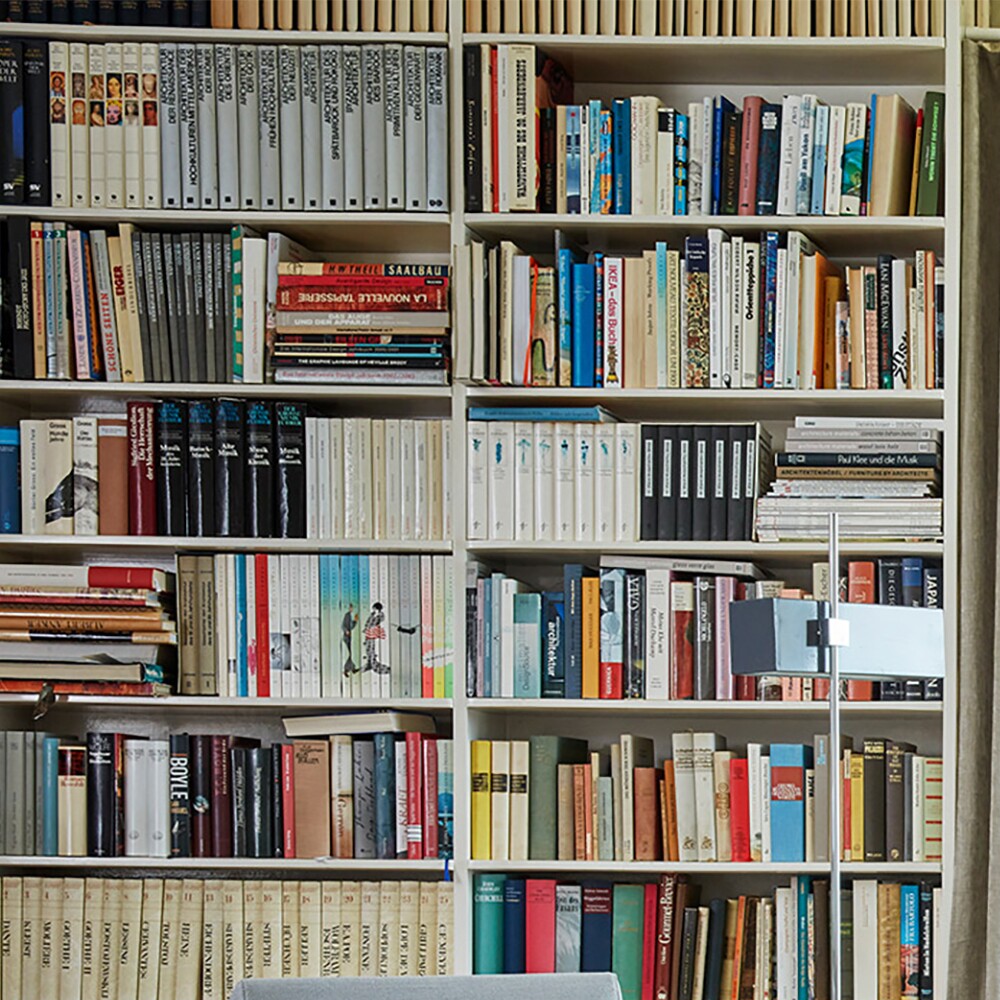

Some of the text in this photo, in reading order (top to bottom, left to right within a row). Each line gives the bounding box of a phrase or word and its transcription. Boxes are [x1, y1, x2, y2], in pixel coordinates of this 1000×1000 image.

[217, 47, 225, 102] ARCHITEKTUR
[246, 50, 254, 75] GOTIK
[268, 50, 276, 114] HOCHKULTUREN
[393, 92, 401, 136] PRIMITIVEN
[414, 104, 422, 121] DER
[189, 121, 197, 185] HOCHKULTUREN
[800, 134, 808, 156] Yukon
[114, 266, 124, 296] EIGER
[389, 265, 441, 275] SAALBAU
[608, 265, 617, 290] IKEA
[881, 263, 889, 281] IAN
[298, 293, 427, 302] LA NOUVELLE TAPISSERIE
[101, 293, 116, 372] SCHÖNE SEITEN
[608, 319, 617, 345] Buch
[838, 455, 918, 464] Paul Klee und die Musik
[628, 577, 639, 610] GALA
[547, 621, 556, 676] architektur
[170, 758, 188, 800] BOYLE
[658, 876, 673, 944] Gourmet-Brevier
[2, 921, 10, 956] DANTE
[63, 921, 71, 964] GOETHE
[121, 923, 129, 965] LESSING
[141, 921, 149, 979] CERVANTES
[180, 923, 190, 957] HEINE
[284, 925, 293, 975] BÜCHNER
[362, 925, 370, 971] FONTANE
[400, 924, 408, 970] LOPE DE
[204, 924, 212, 996] EICHENDORFF
